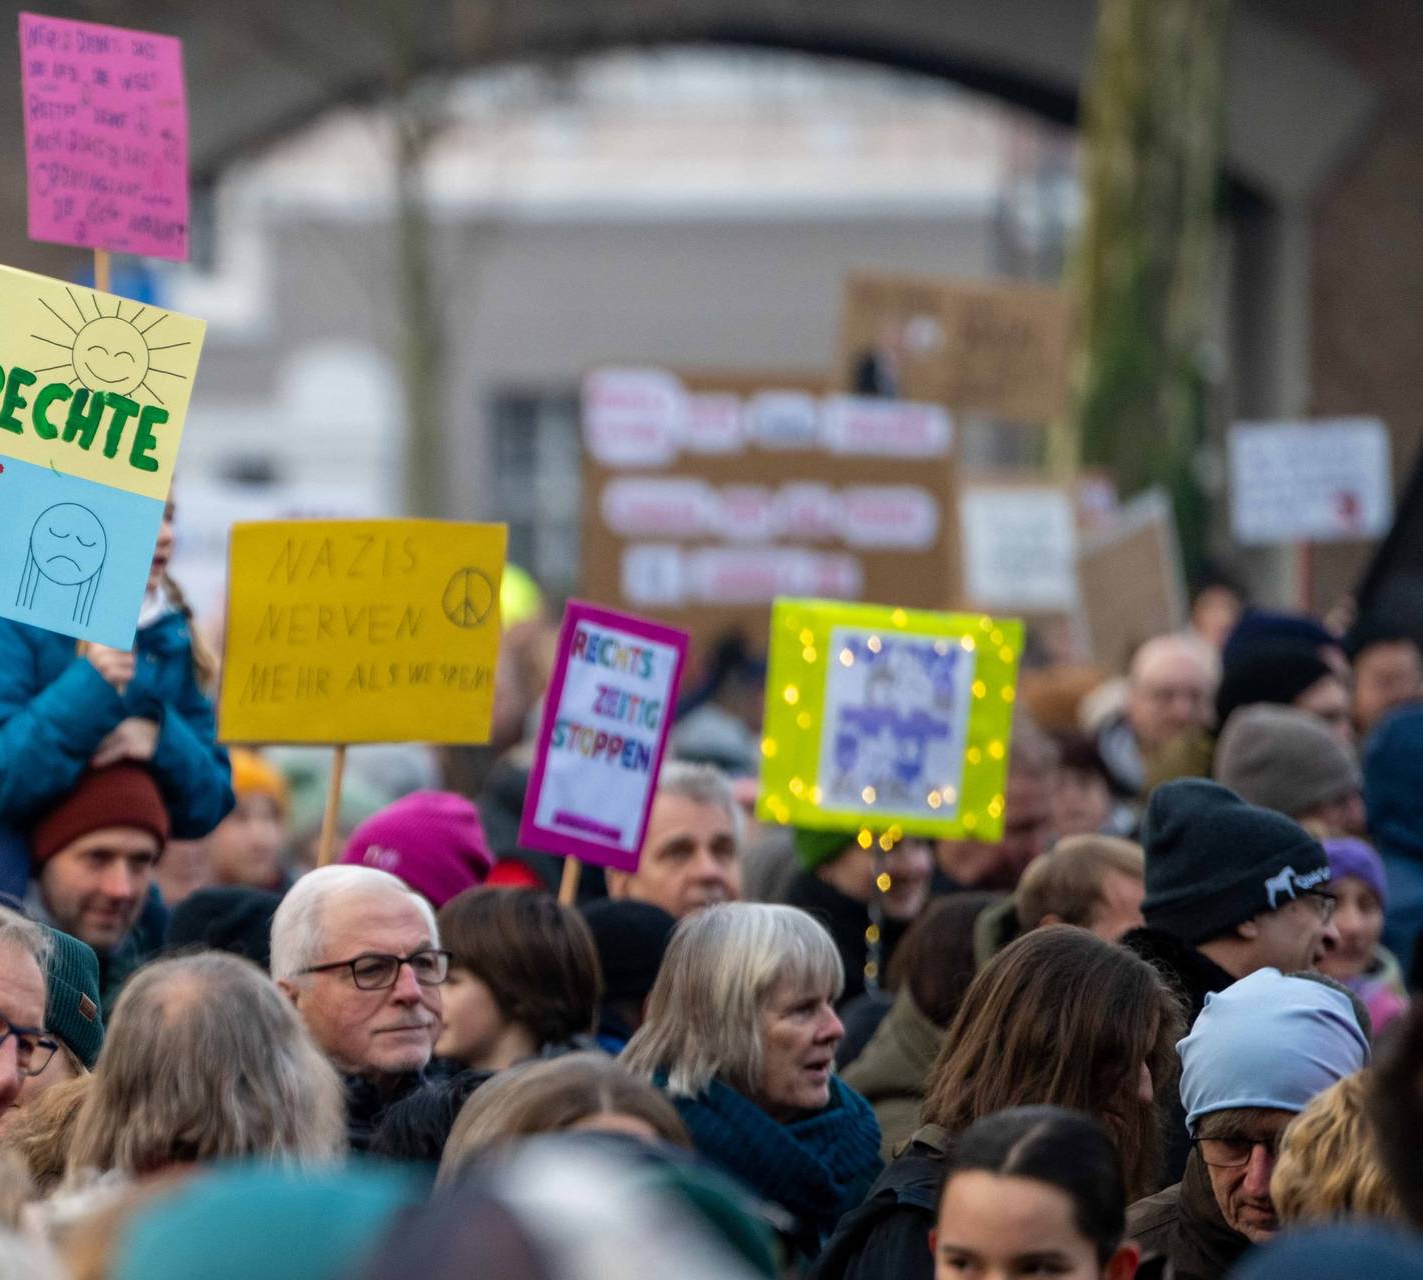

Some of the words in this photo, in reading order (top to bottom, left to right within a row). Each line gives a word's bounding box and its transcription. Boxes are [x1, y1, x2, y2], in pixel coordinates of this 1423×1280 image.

[267, 534, 416, 585] NAZIS
[254, 602, 424, 647] NERVEN
[570, 628, 655, 681] RECHTS
[239, 661, 332, 705] MEHR
[345, 661, 400, 694] ALS
[592, 682, 662, 732] ZEITIG
[551, 717, 652, 774] STOPPEN
